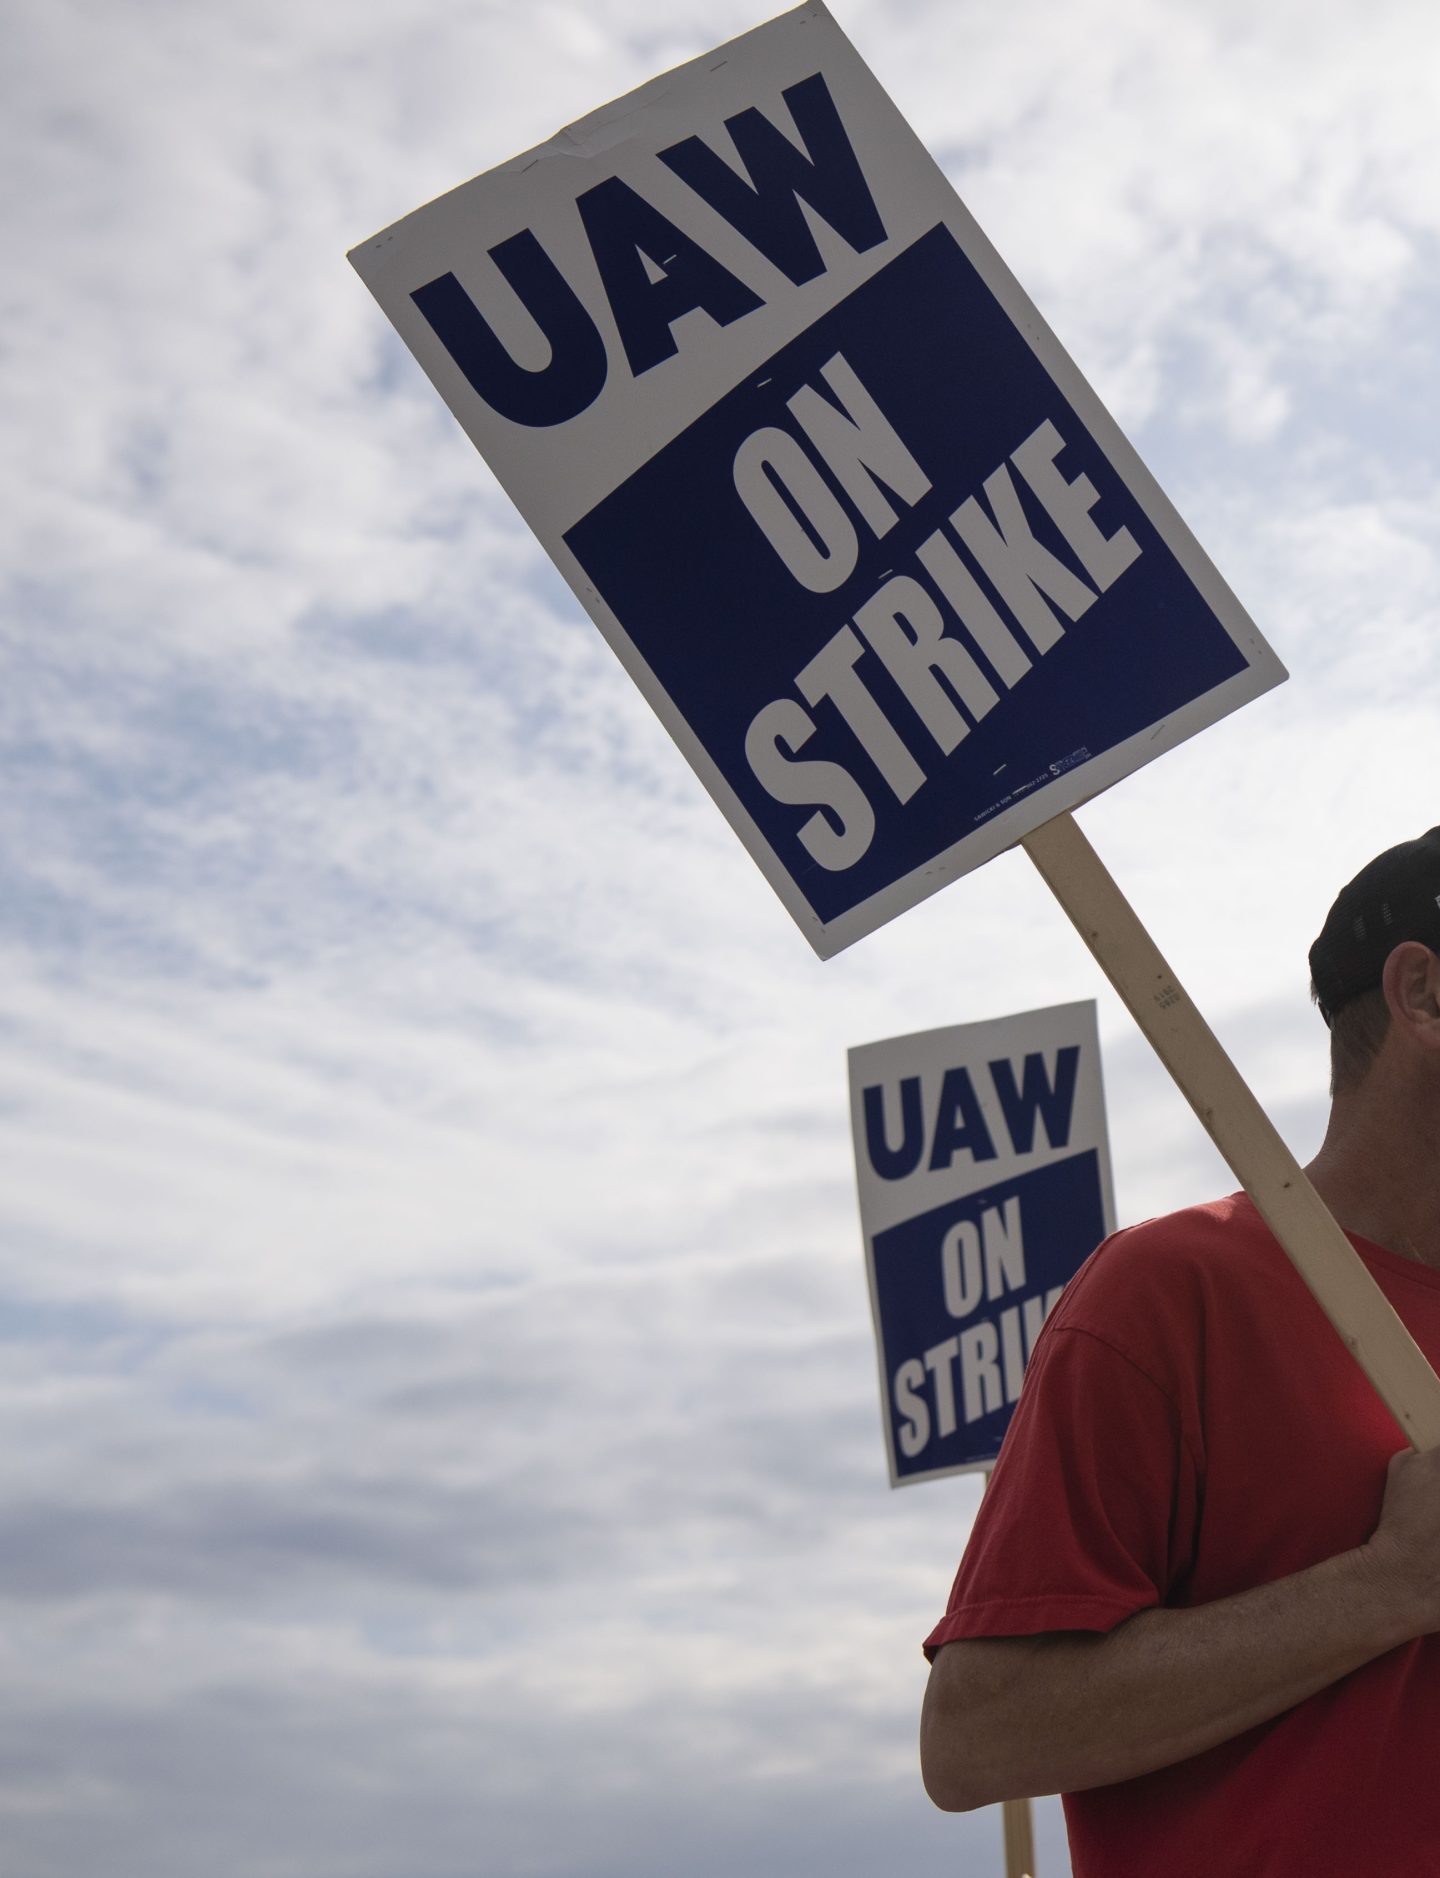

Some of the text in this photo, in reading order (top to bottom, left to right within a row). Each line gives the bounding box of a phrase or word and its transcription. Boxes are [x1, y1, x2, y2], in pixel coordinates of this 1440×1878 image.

[408, 71, 889, 428] UAW
[732, 350, 934, 594] ON
[743, 417, 1144, 872] STRIKE
[861, 1044, 1081, 1182] UAW
[940, 1195, 1027, 1319] ON
